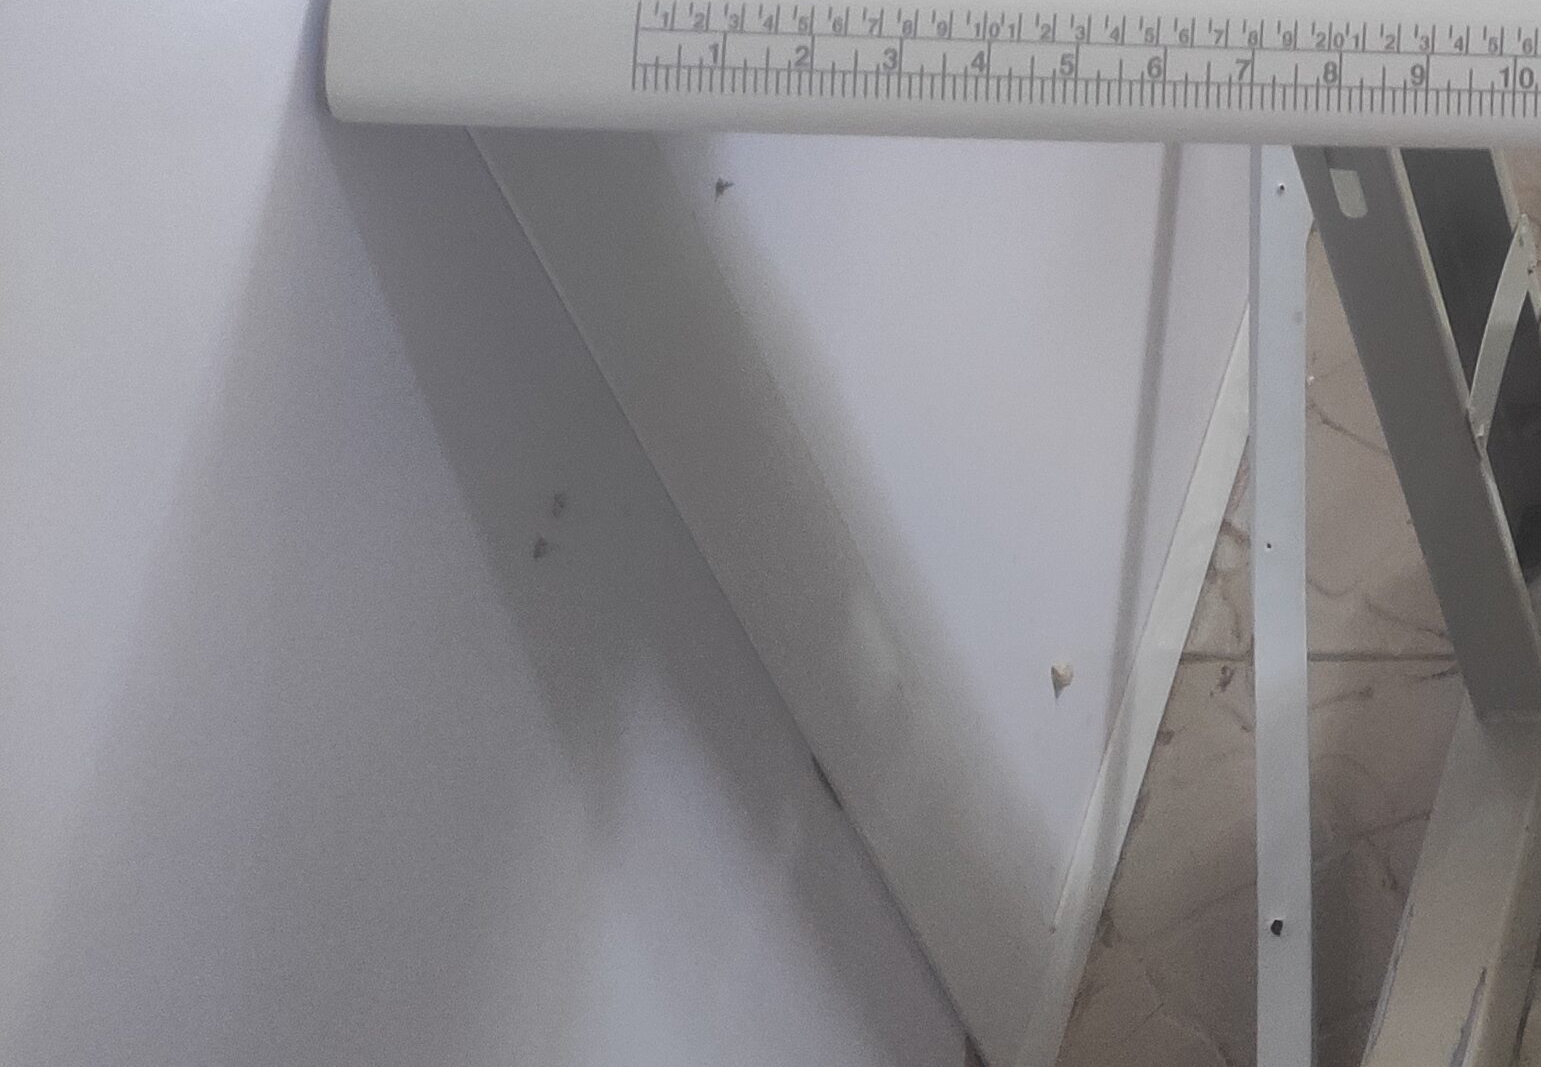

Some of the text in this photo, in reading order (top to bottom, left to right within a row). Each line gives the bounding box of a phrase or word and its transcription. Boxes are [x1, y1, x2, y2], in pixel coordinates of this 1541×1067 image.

[708, 43, 720, 64] 1
[795, 45, 811, 67] 2
[882, 47, 898, 71] 3
[971, 50, 986, 73] 4
[1059, 53, 1075, 77] 5
[1147, 55, 1163, 79] 6
[1235, 58, 1251, 81] 7
[1322, 60, 1338, 84] 8
[1410, 63, 1426, 87] 9
